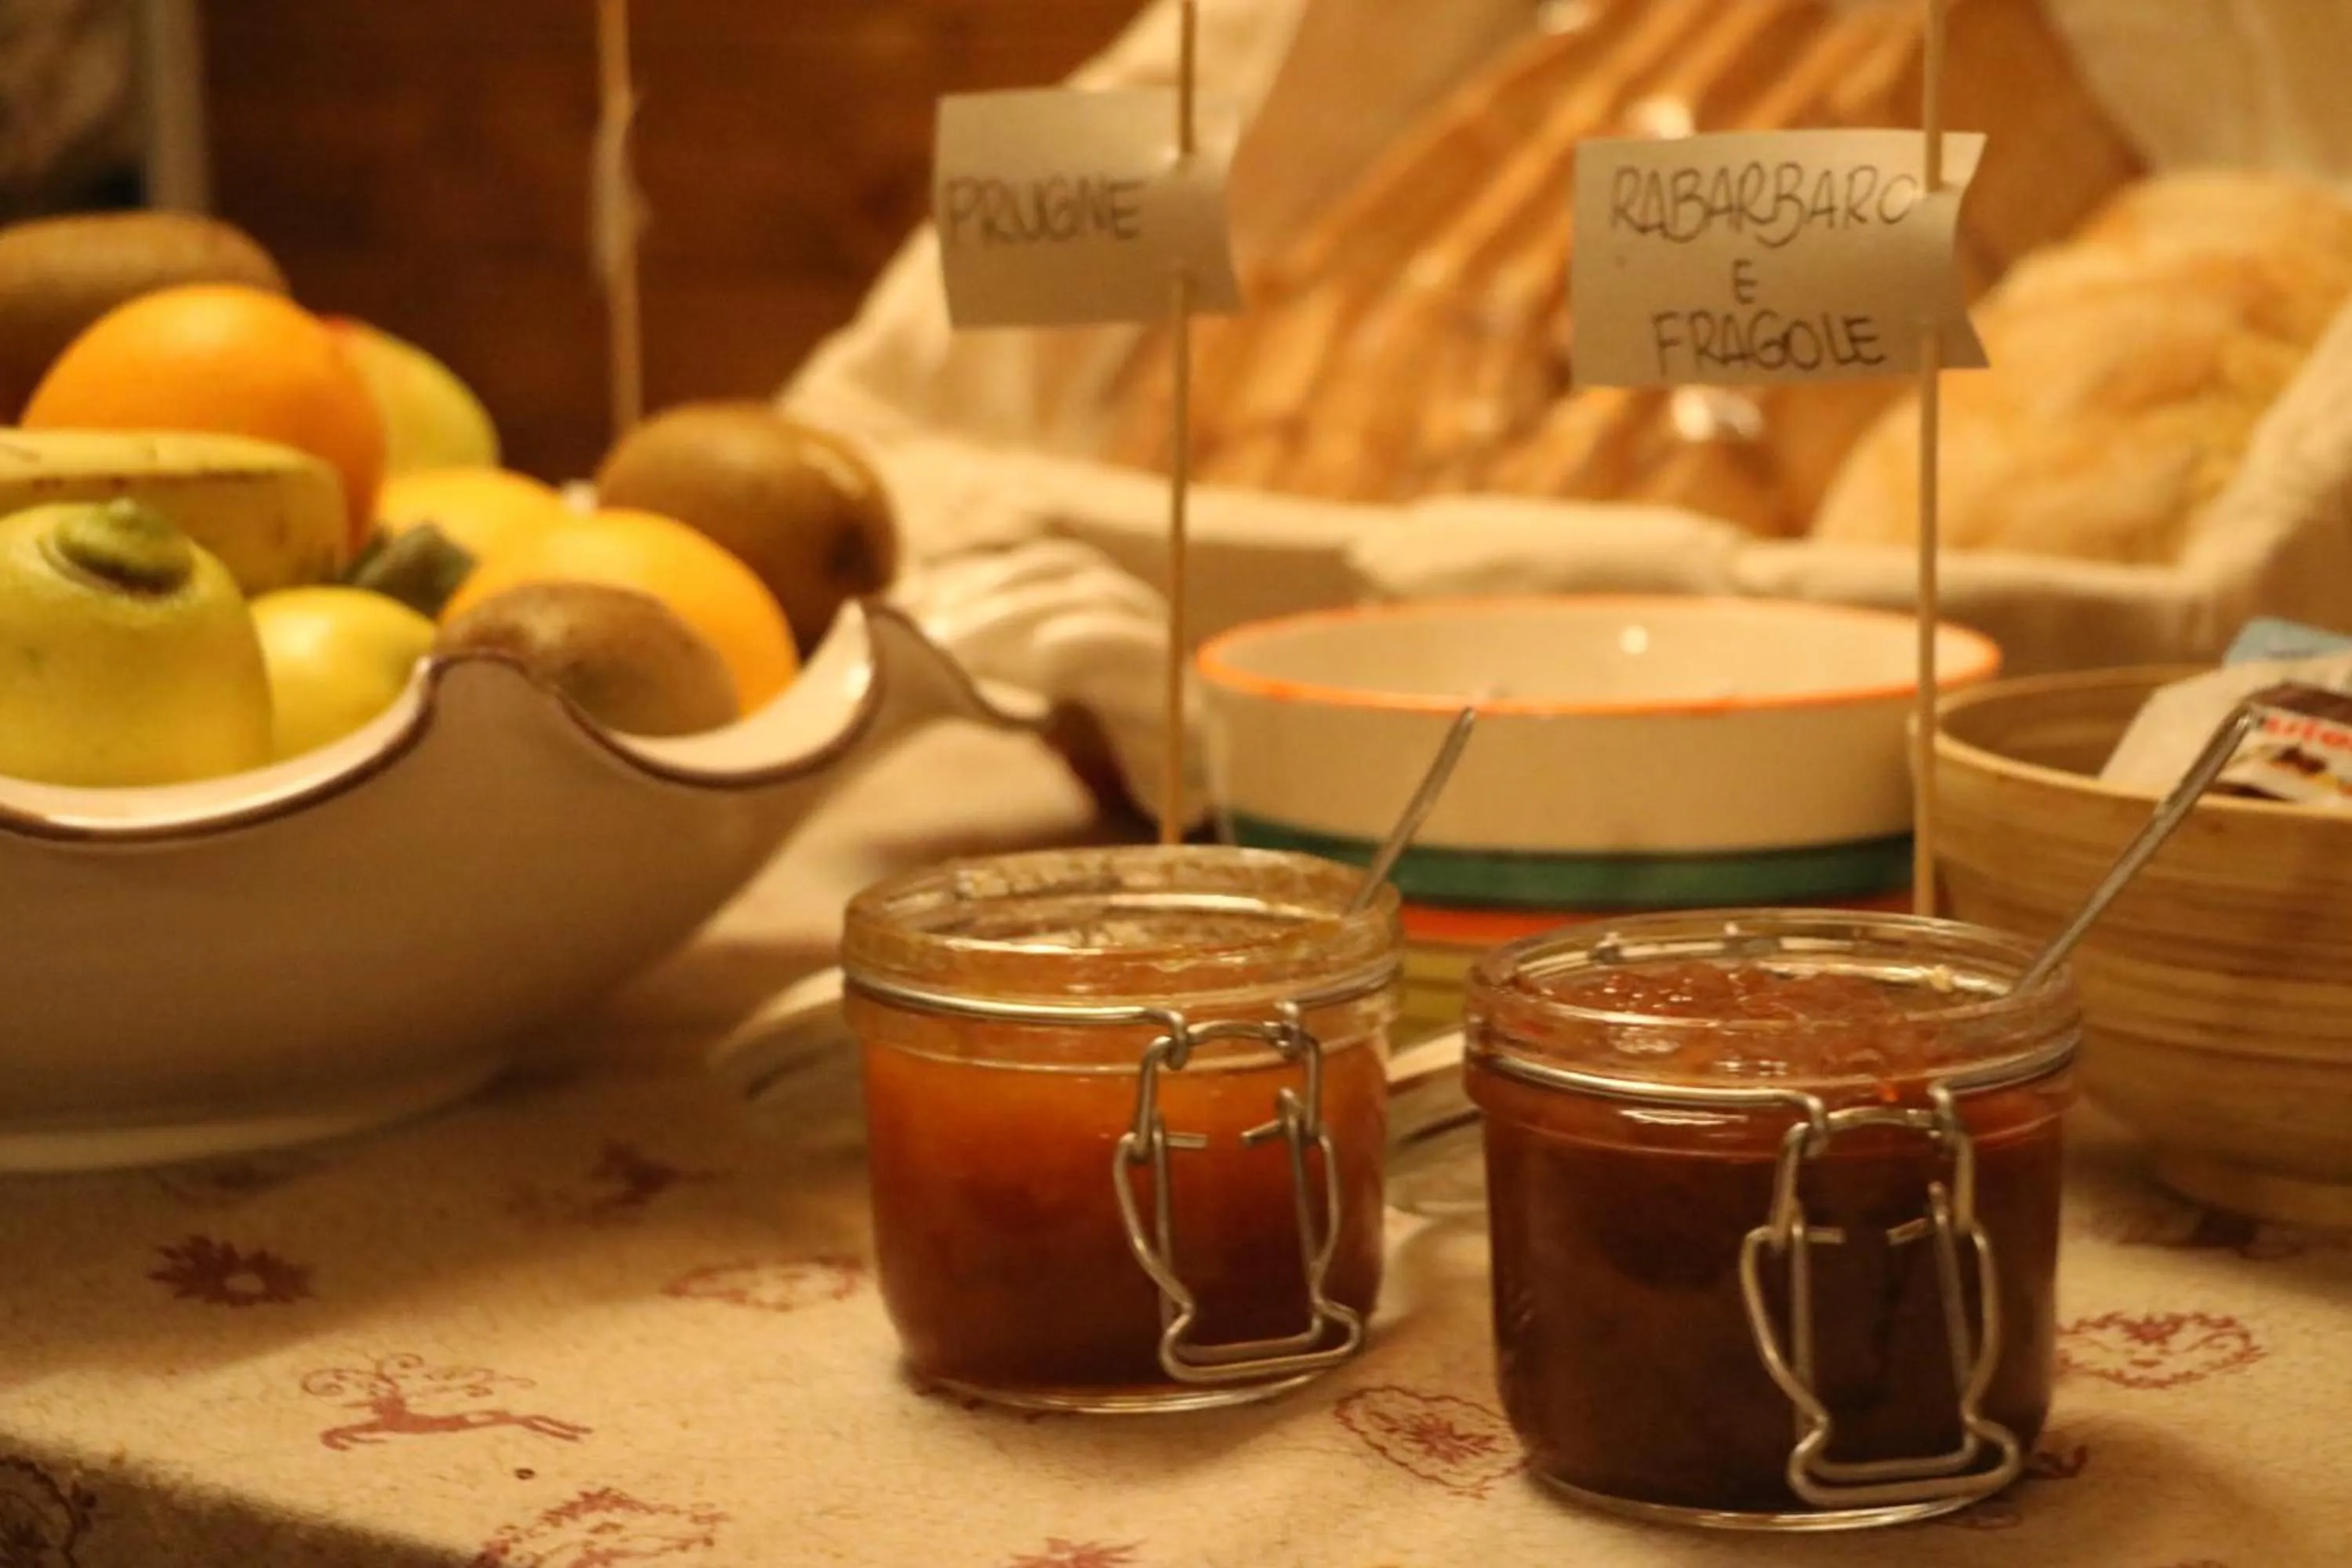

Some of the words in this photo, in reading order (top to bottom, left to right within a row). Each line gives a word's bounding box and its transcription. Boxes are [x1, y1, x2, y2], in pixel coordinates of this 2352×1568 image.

[946, 175, 1143, 244] PRUGNE
[1732, 258, 1759, 305] E
[1652, 310, 1887, 376] FRAGOLE
